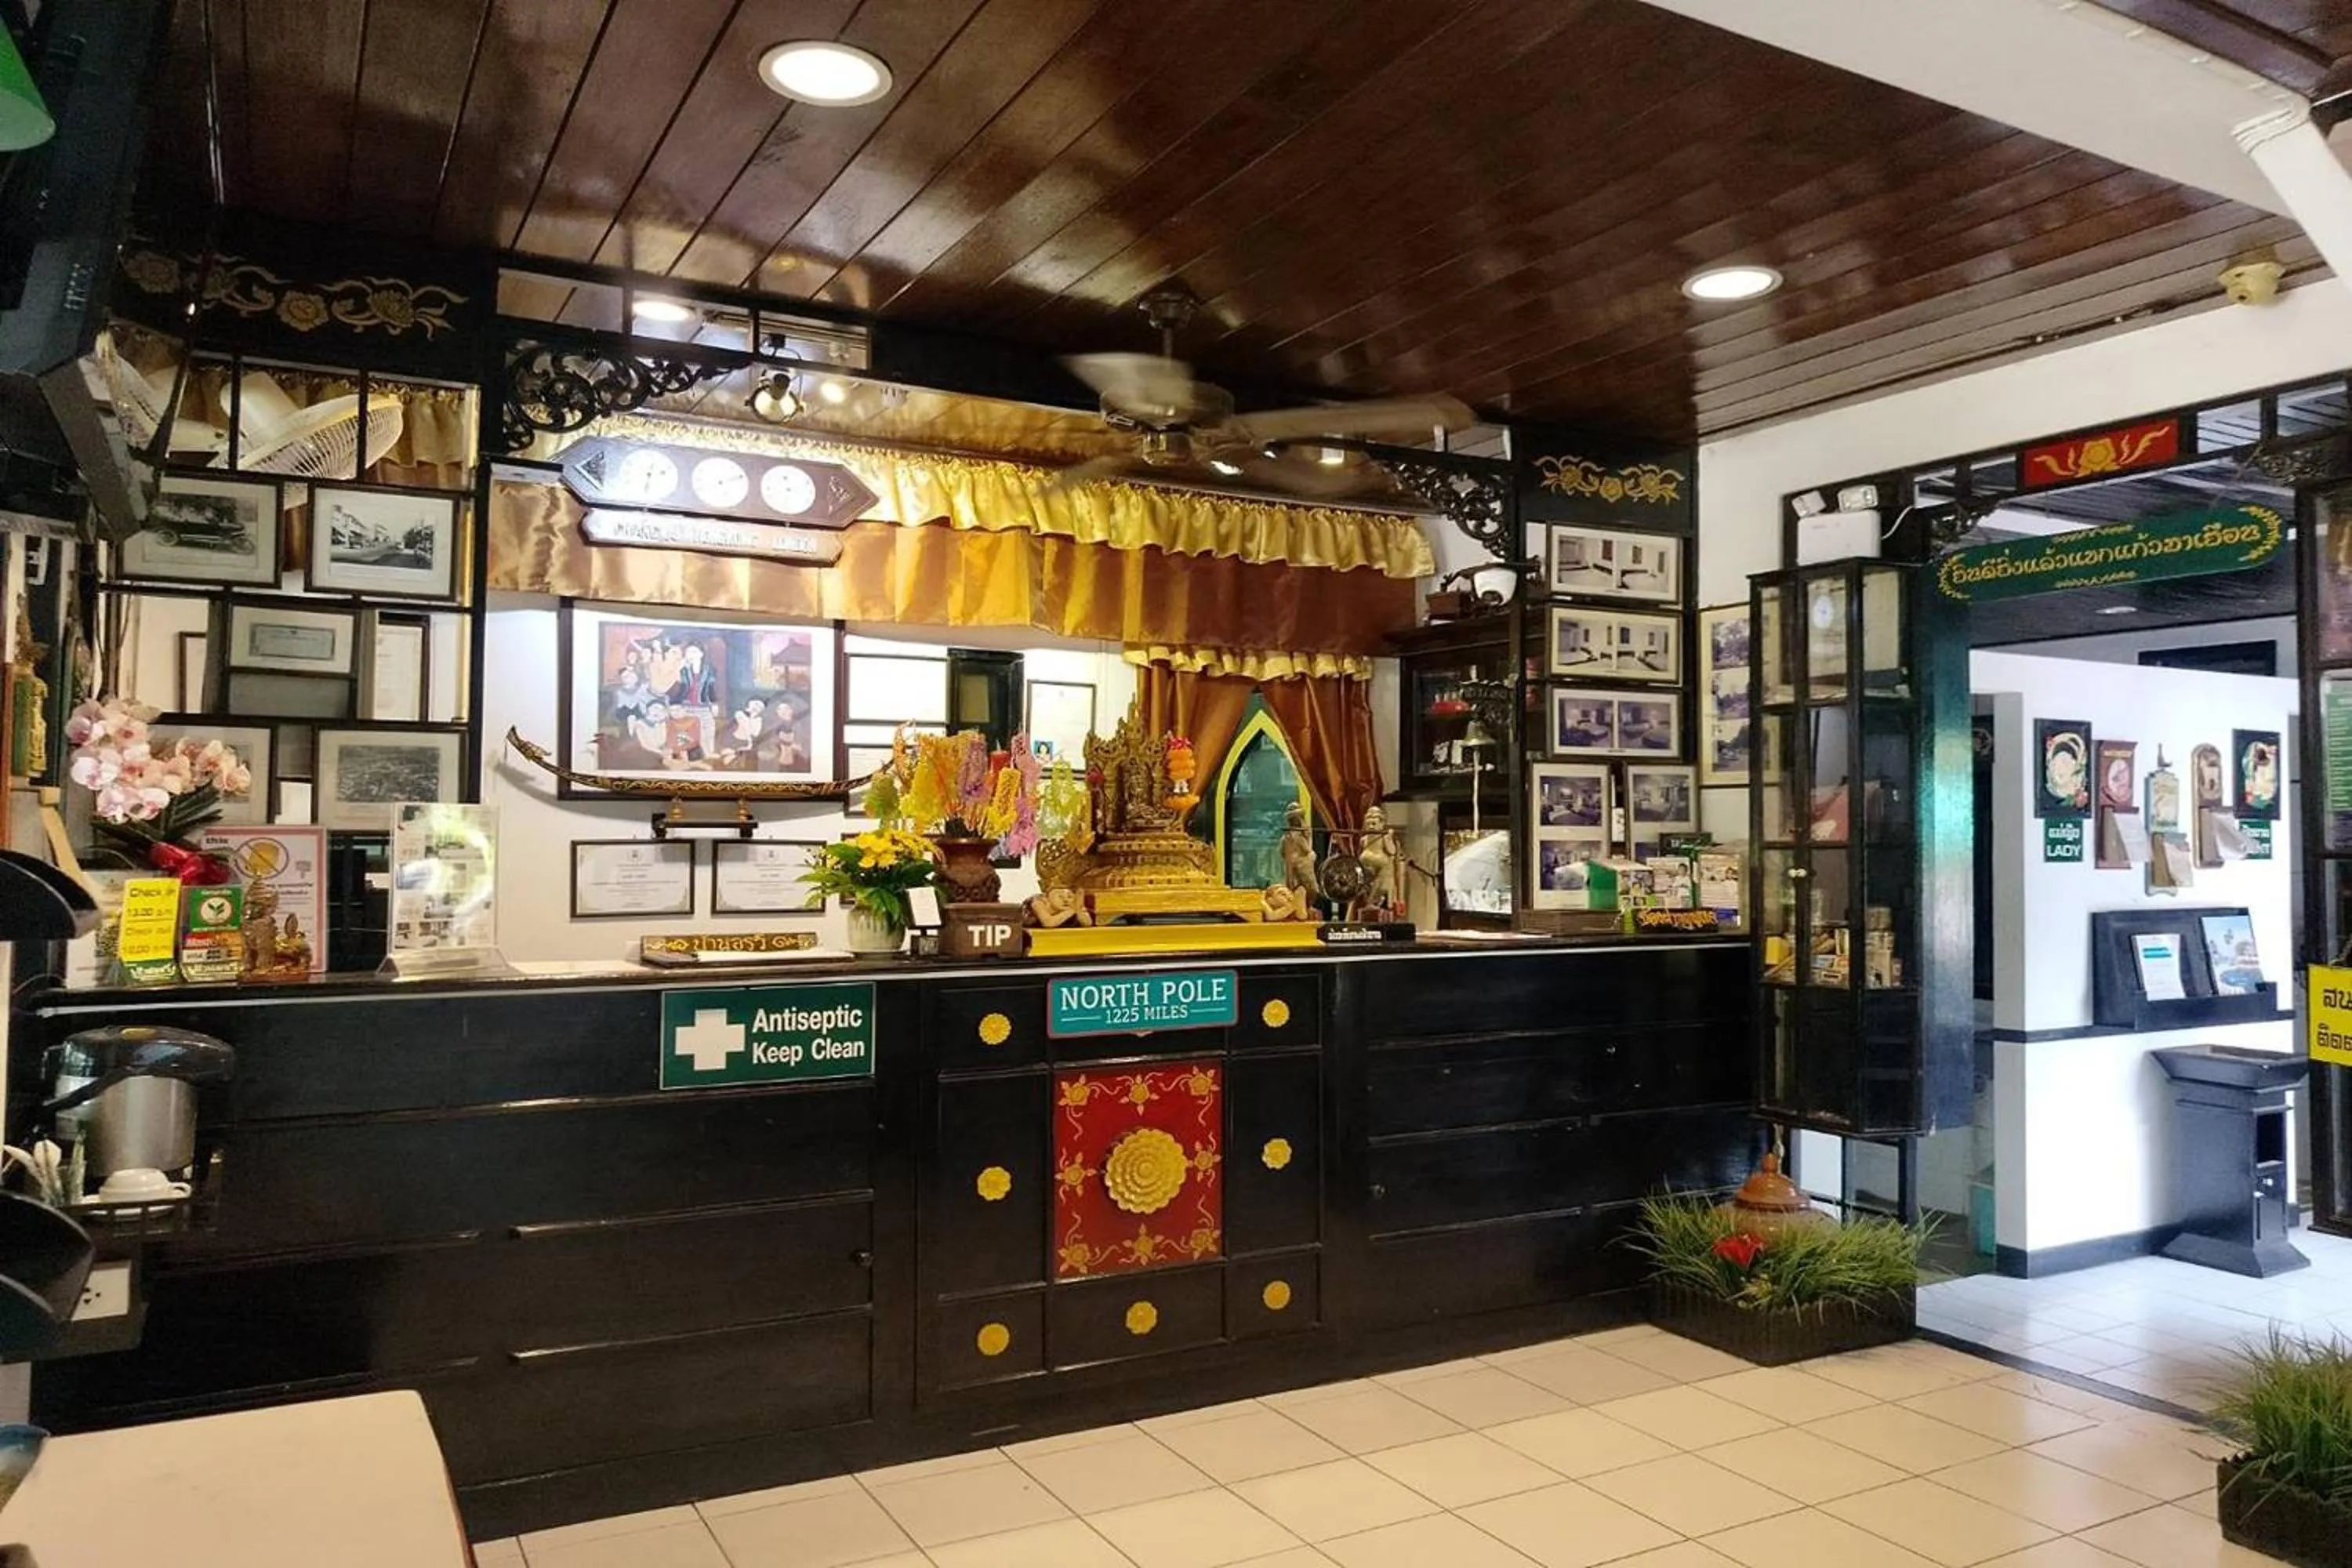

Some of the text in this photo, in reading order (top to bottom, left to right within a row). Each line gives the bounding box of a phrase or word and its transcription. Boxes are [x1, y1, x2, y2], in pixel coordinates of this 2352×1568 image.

[2046, 844, 2082, 857] LADY
[967, 924, 1012, 947] TIP
[1060, 978, 1227, 1011] NORTH POLE
[752, 1004, 863, 1035] Antiseptic
[1105, 1004, 1189, 1024] 1225 MILES
[752, 1037, 866, 1067] Keep Clean
